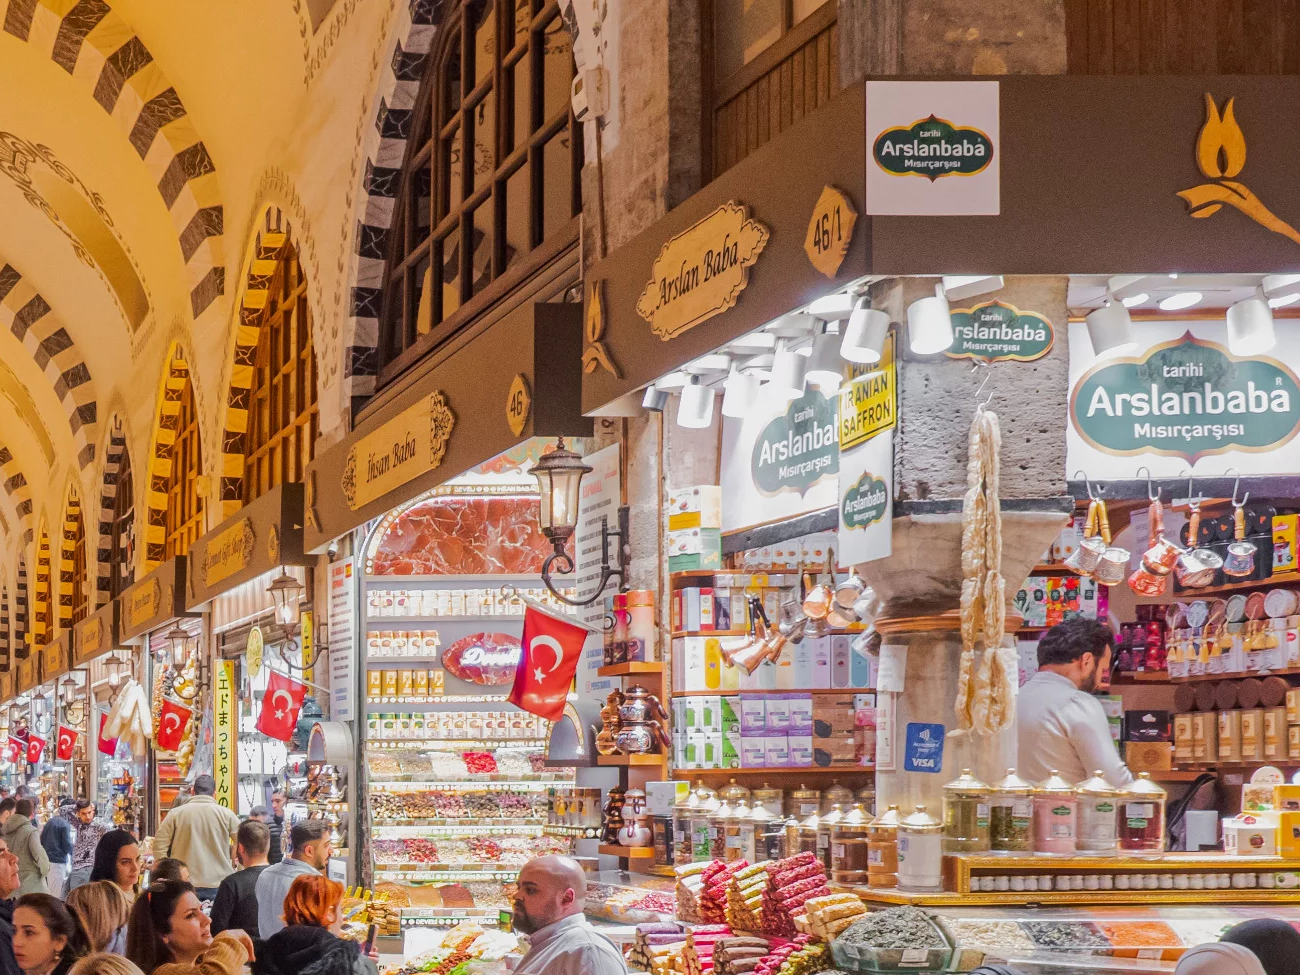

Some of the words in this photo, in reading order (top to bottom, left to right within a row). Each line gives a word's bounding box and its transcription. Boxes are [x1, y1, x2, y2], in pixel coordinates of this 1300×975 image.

[881, 139, 985, 156] Arslanbaba
[904, 159, 961, 169] Mısırçarşısı
[813, 204, 842, 254] 46/1
[656, 259, 700, 310] Arslan
[703, 233, 739, 283] Baba
[981, 313, 1003, 321] tarihi
[954, 322, 1046, 341] rslanbaba
[962, 340, 1021, 352] Mısırçarşısı
[1162, 362, 1204, 378] tarihi
[844, 371, 888, 410] IRANIAN
[1086, 380, 1291, 417] Arslanbaba
[510, 390, 523, 418] 46
[794, 405, 815, 423] tarihi
[843, 398, 890, 437] SAFFRON
[758, 413, 840, 467] Arslanbab
[1133, 423, 1245, 441] Mısırçarşısı
[392, 431, 416, 469] Baba
[778, 454, 831, 480] Mısırçarşısı
[844, 489, 886, 514] Arslanbaba
[911, 757, 935, 767] VISA
